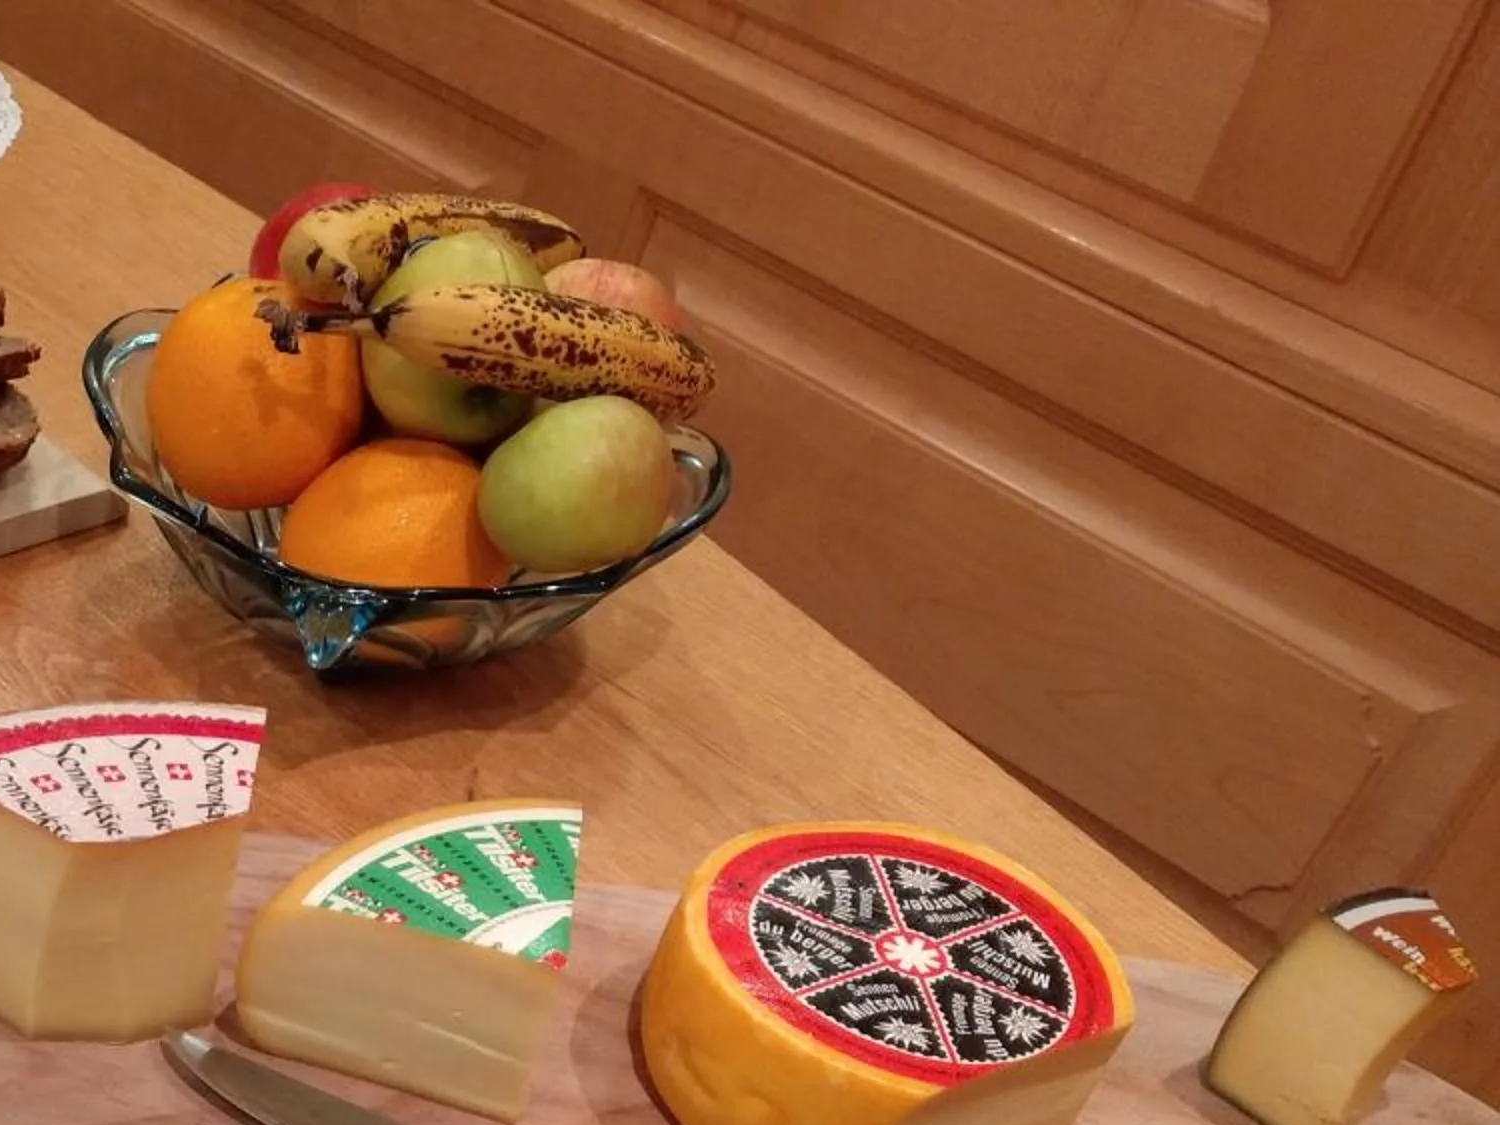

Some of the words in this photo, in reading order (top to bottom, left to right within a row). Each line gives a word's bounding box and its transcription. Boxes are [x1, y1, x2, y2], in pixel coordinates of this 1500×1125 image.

[789, 928, 855, 972] berger
[969, 939, 1052, 991] Mutschli
[840, 993, 921, 1022] Mutschli
